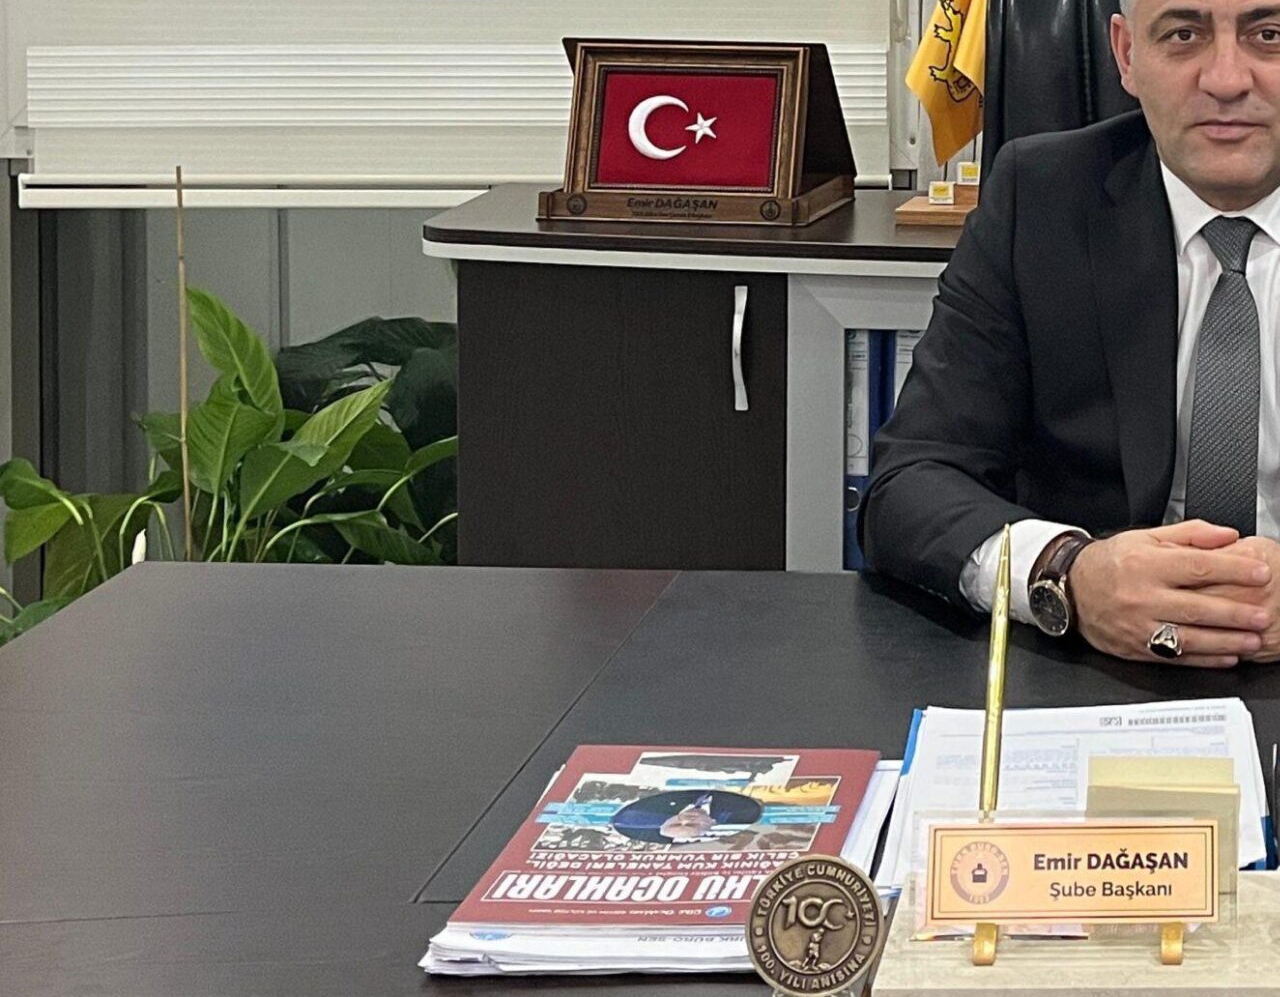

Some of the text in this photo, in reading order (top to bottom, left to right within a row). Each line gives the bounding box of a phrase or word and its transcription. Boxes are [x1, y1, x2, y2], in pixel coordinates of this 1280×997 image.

[627, 196, 719, 211] Emir DAĞAŞAN
[585, 860, 673, 870] TANELERİ
[630, 852, 706, 861] YUMRUK
[677, 861, 715, 870] KUM
[720, 860, 784, 870] AĞINIK
[1033, 848, 1189, 874] Emir DAĞAŞAN
[491, 874, 690, 902] OCAKLARI
[757, 864, 876, 926] TÜRKİYE CUMHURİYETİ
[1050, 880, 1173, 902] Şube Başkanı
[779, 972, 806, 989] YILI
[811, 953, 865, 989] ANISINA
